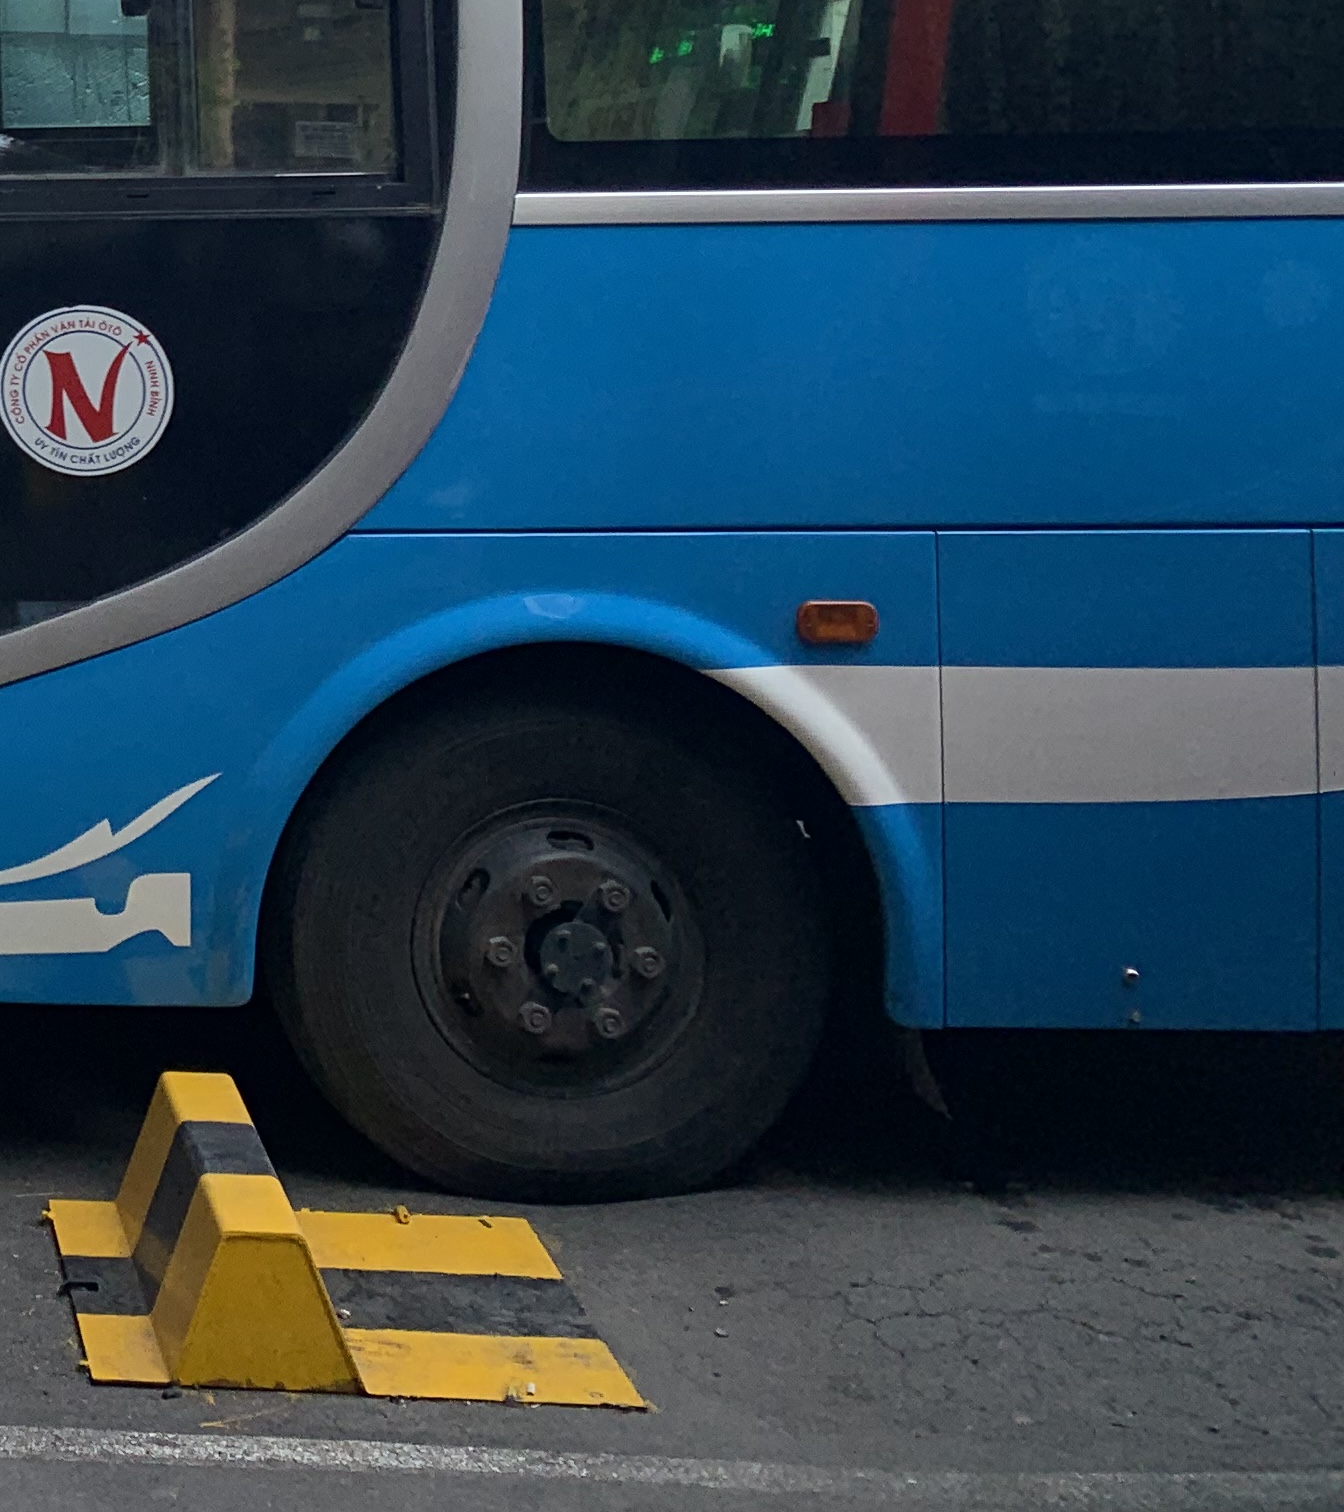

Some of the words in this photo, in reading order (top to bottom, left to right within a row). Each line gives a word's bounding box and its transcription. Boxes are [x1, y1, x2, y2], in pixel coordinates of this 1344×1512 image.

[9, 374, 22, 388] TY
[146, 359, 161, 388] NINH
[41, 341, 135, 444] N
[10, 392, 26, 425] CÔNG
[34, 437, 48, 453] UY
[50, 447, 68, 462] TÍN
